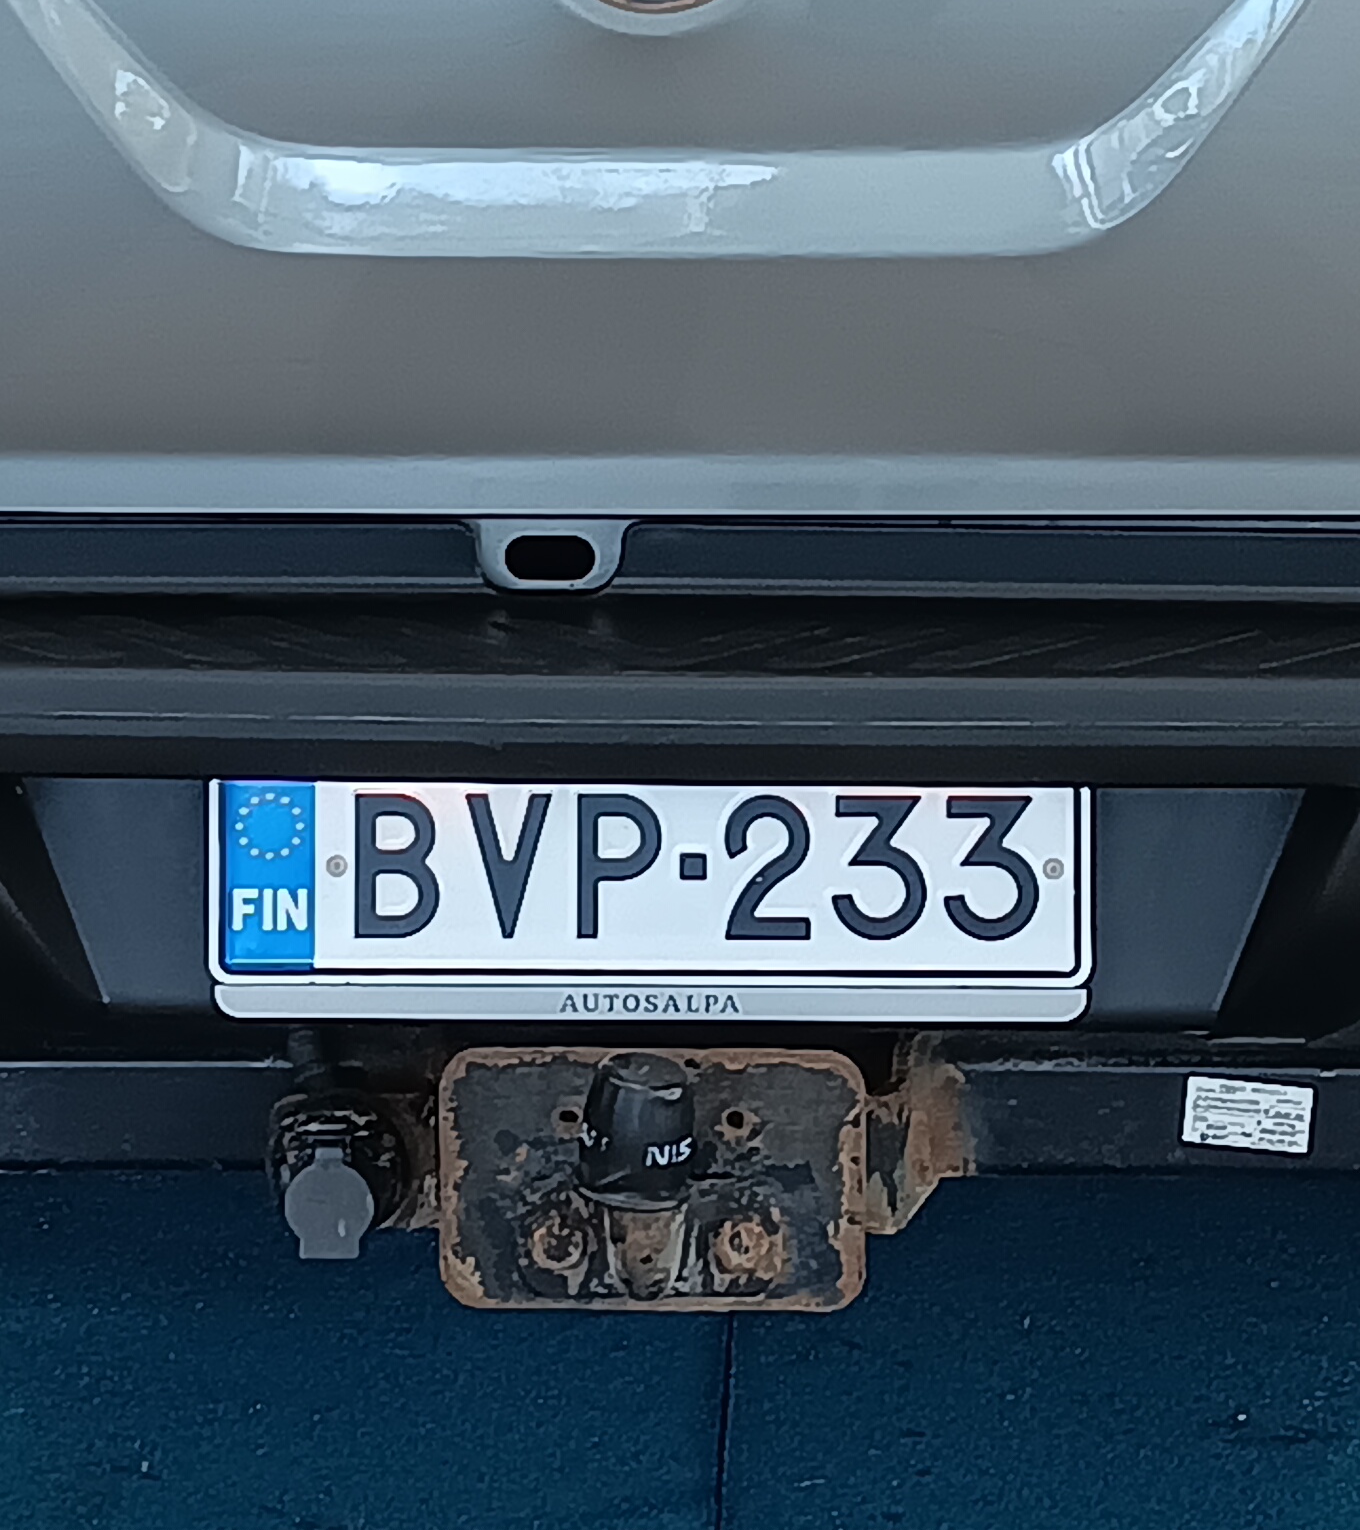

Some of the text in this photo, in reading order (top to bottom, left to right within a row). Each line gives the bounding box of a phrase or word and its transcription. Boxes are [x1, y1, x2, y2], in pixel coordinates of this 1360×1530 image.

[352, 792, 1042, 943] BVP-233
[230, 887, 310, 933] FIN
[558, 992, 741, 1015] AUTOSALPA
